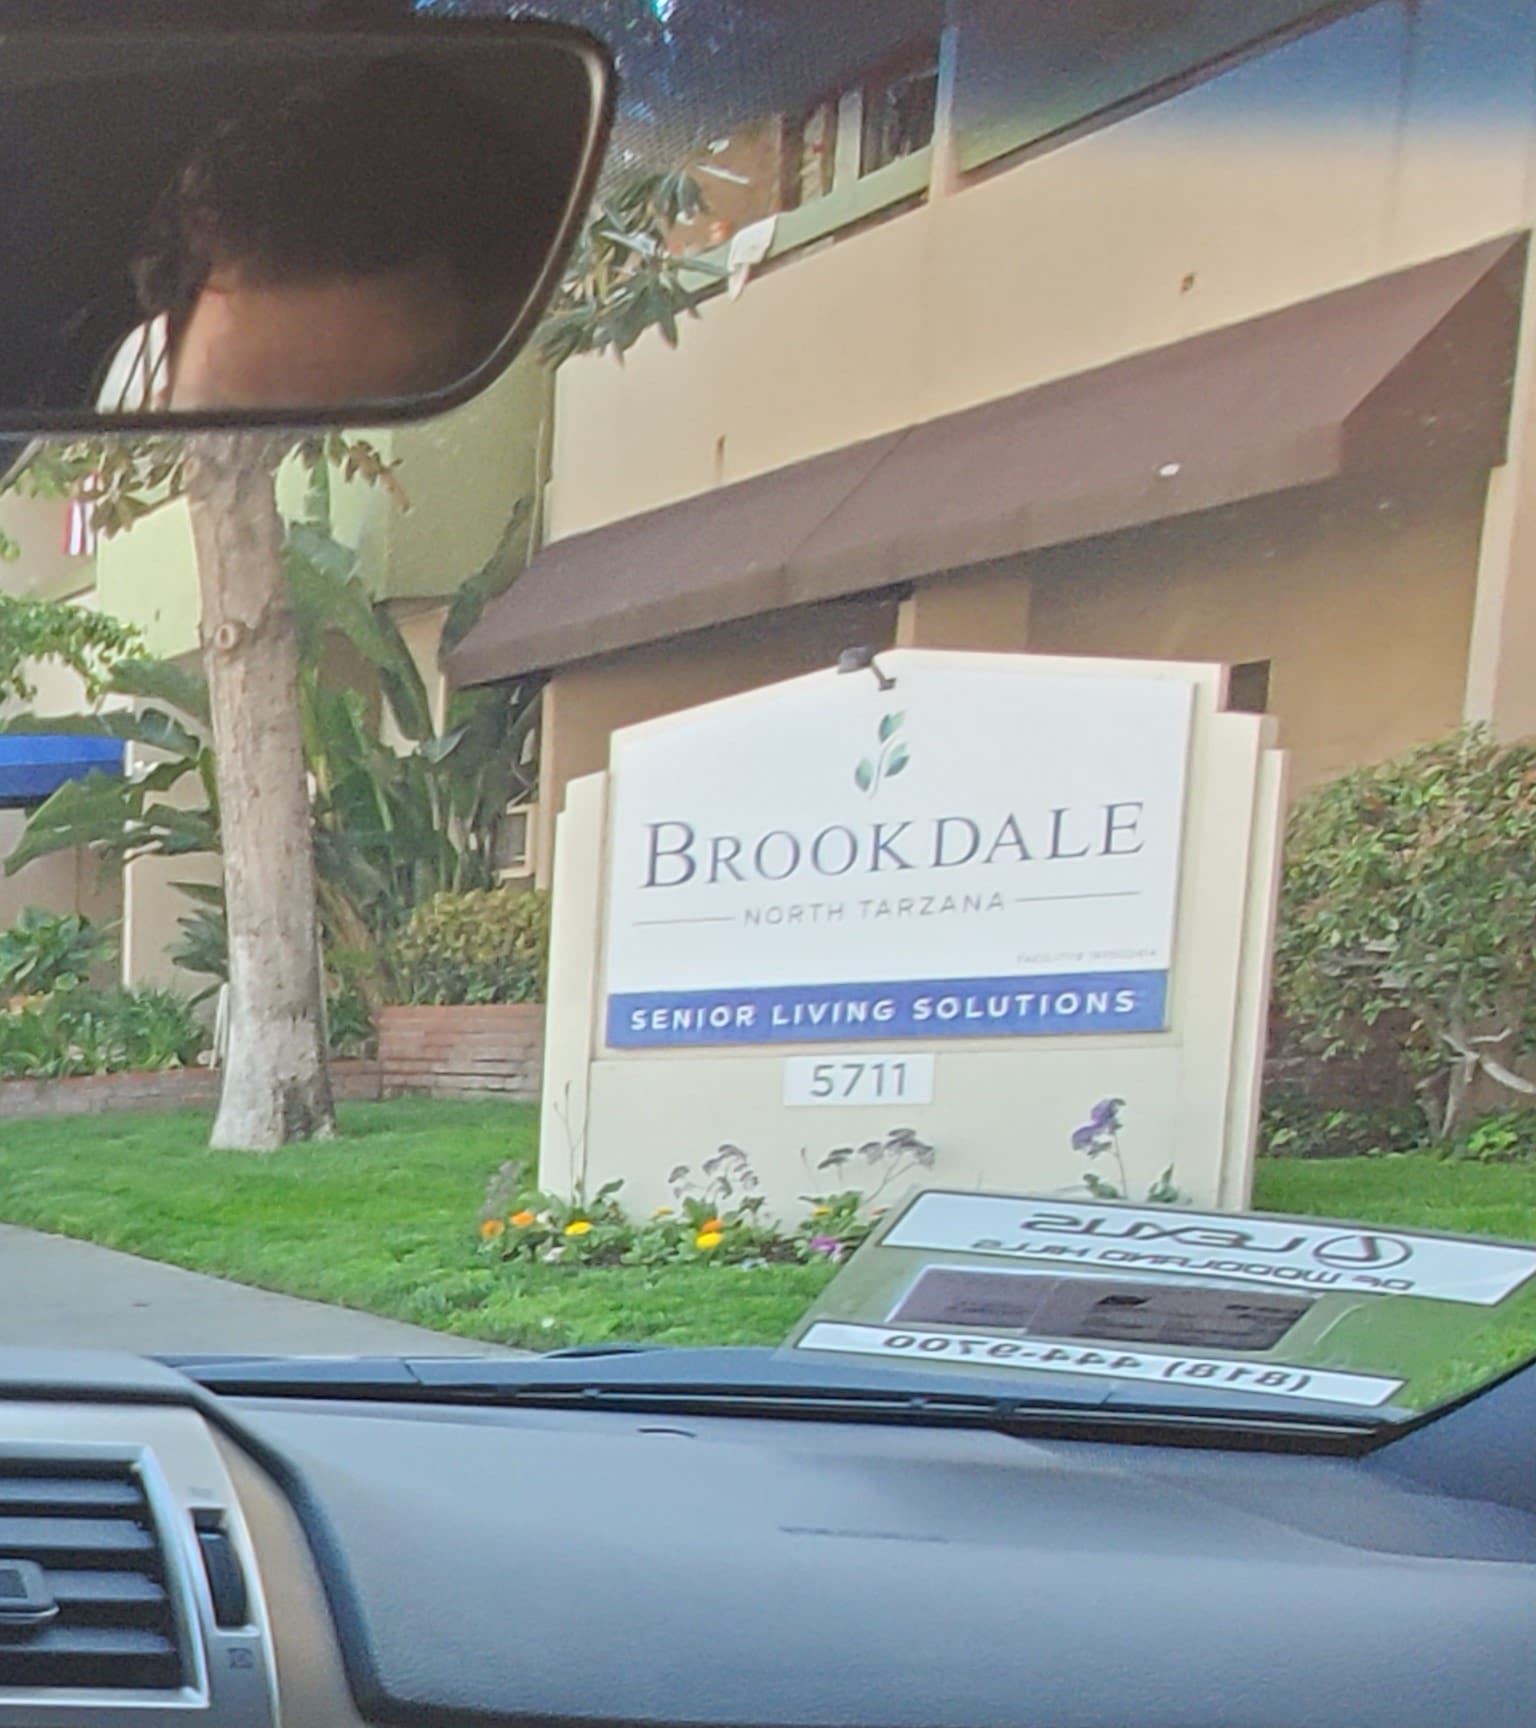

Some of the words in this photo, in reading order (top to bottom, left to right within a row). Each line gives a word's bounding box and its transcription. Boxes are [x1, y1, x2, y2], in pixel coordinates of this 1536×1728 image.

[641, 800, 1147, 889] BROOKDALE
[744, 900, 845, 927] NORTH
[860, 891, 1006, 920] TARZANA
[631, 1003, 756, 1032] SENIOR
[772, 998, 896, 1026] LIVING
[913, 989, 1135, 1021] SOLUTIONS
[810, 1061, 908, 1098] 5711
